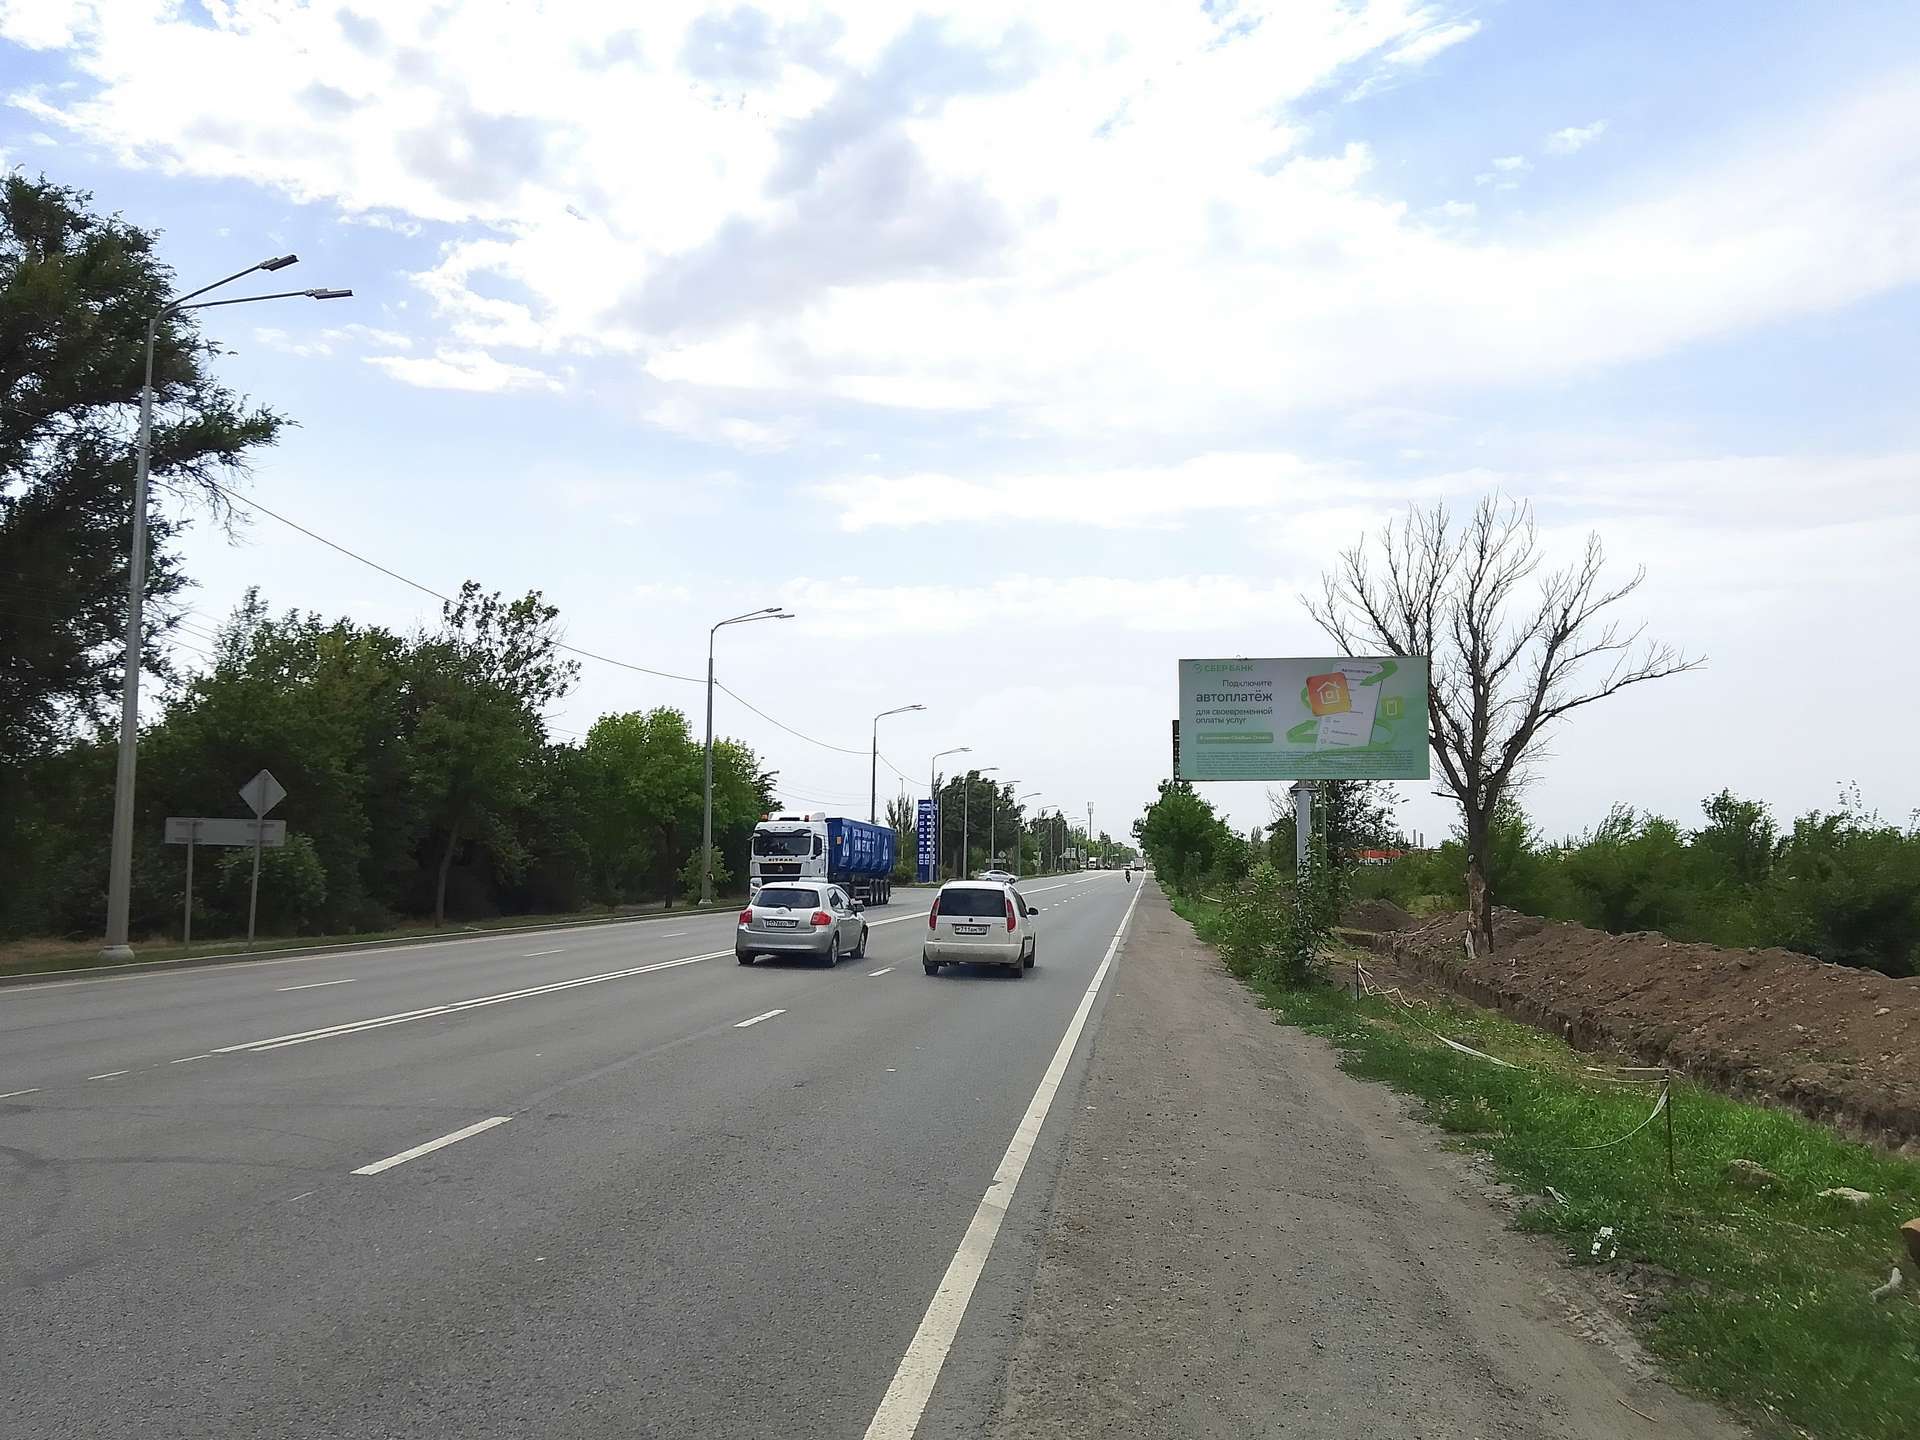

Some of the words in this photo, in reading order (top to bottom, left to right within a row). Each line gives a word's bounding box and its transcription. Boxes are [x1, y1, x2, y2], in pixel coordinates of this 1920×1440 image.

[1222, 680, 1273, 688] Подключите
[1196, 690, 1273, 702] автоплатёж
[1195, 708, 1211, 716] для
[1212, 706, 1273, 716] своевременной
[1226, 717, 1247, 725] услуг
